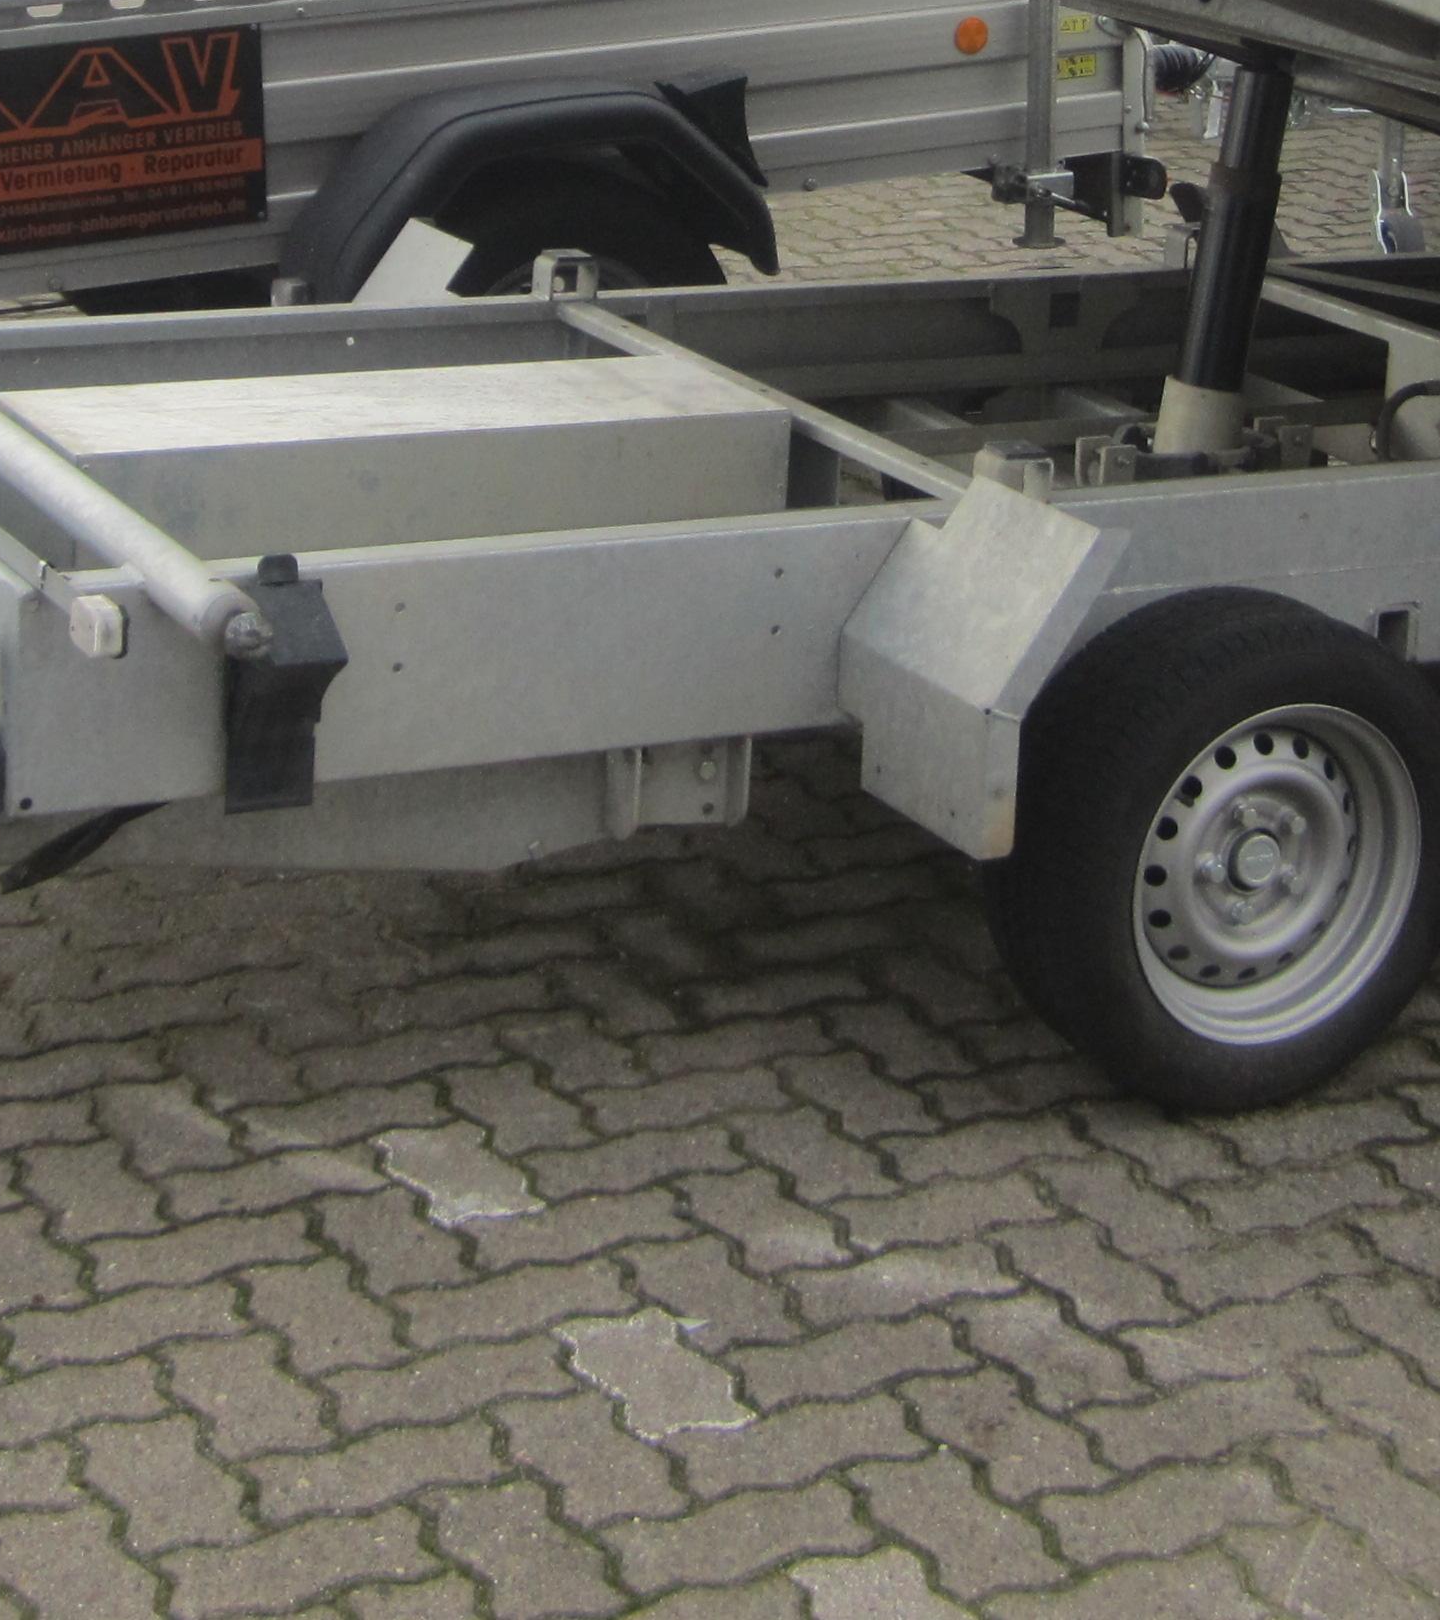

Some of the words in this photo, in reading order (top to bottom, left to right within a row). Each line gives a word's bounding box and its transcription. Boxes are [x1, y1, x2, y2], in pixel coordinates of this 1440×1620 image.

[162, 119, 243, 145] VERTRIEB
[0, 160, 122, 192] Vermietung
[143, 145, 244, 177] Reparatur
